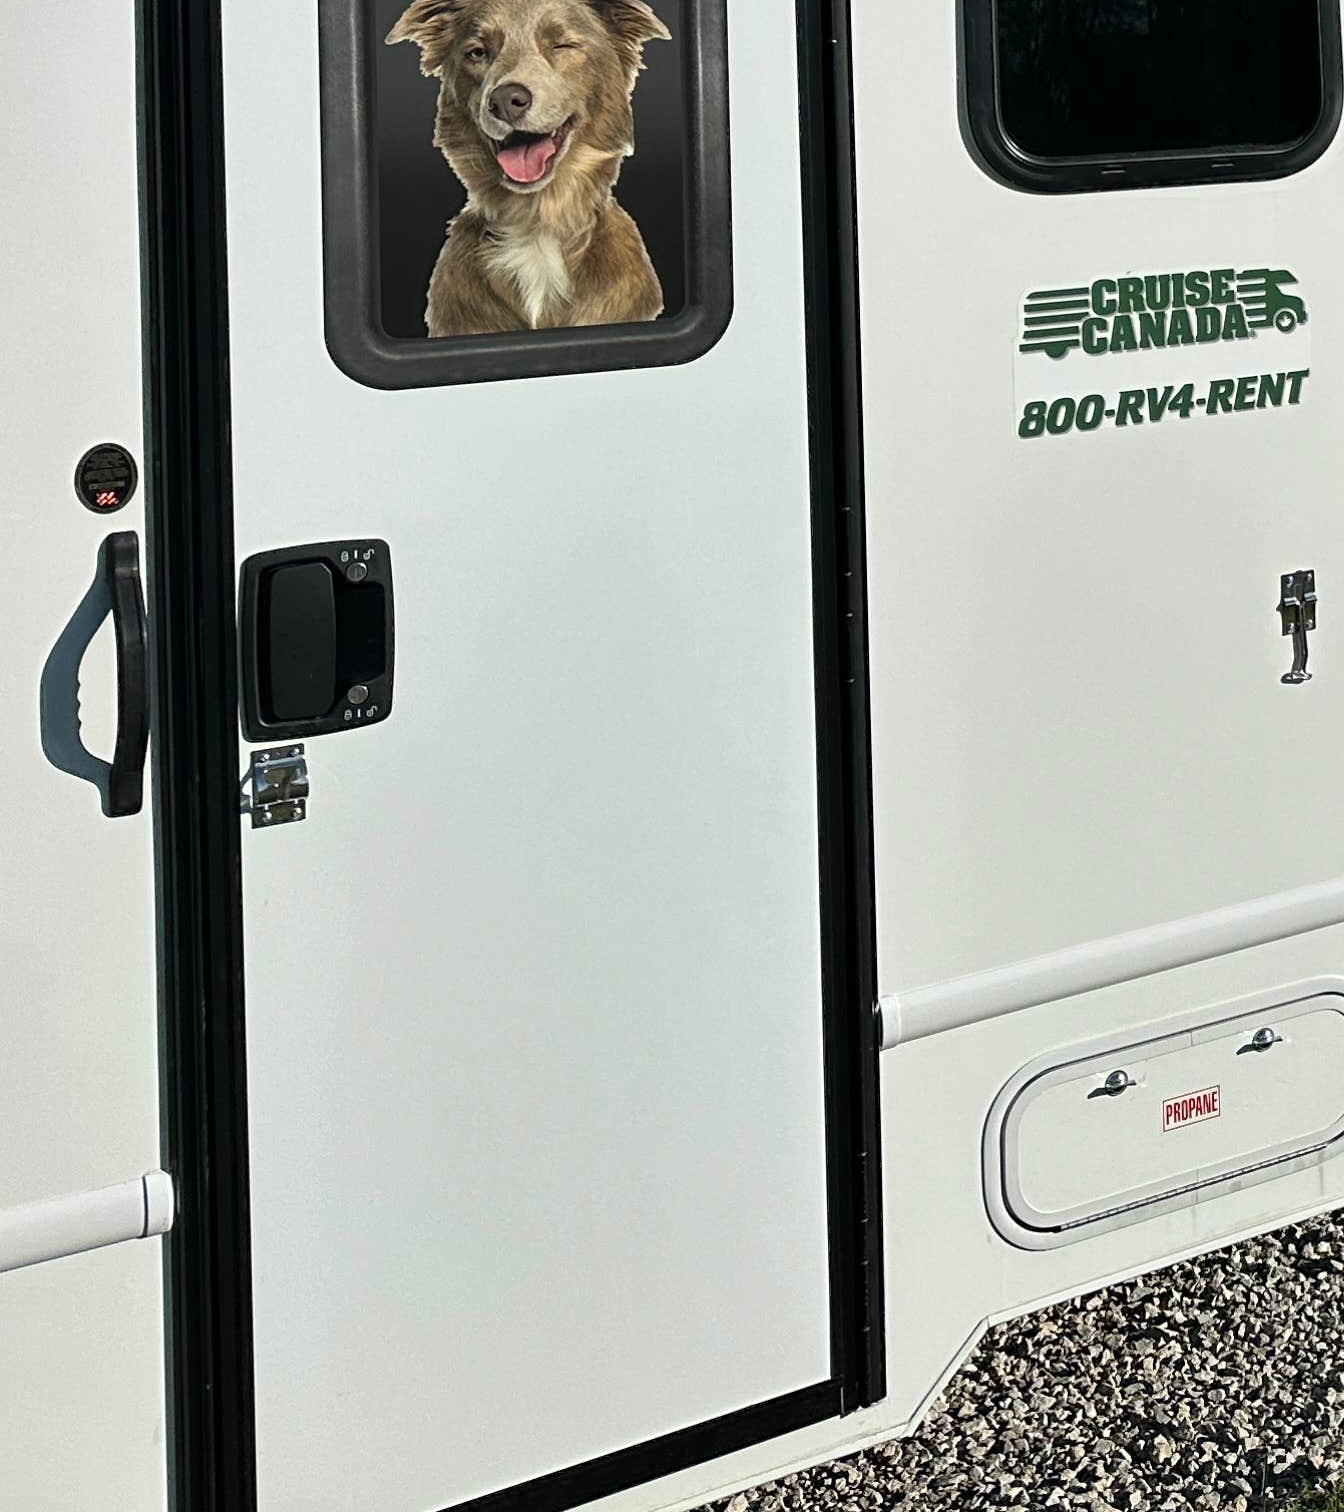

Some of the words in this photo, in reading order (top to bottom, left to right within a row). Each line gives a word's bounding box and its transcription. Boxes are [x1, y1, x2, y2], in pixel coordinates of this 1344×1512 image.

[1091, 268, 1236, 317] CRUISE
[1081, 303, 1251, 356] CANADA
[1018, 367, 1310, 439] 800-RV4-RENT
[1166, 1090, 1218, 1126] PROPANE
